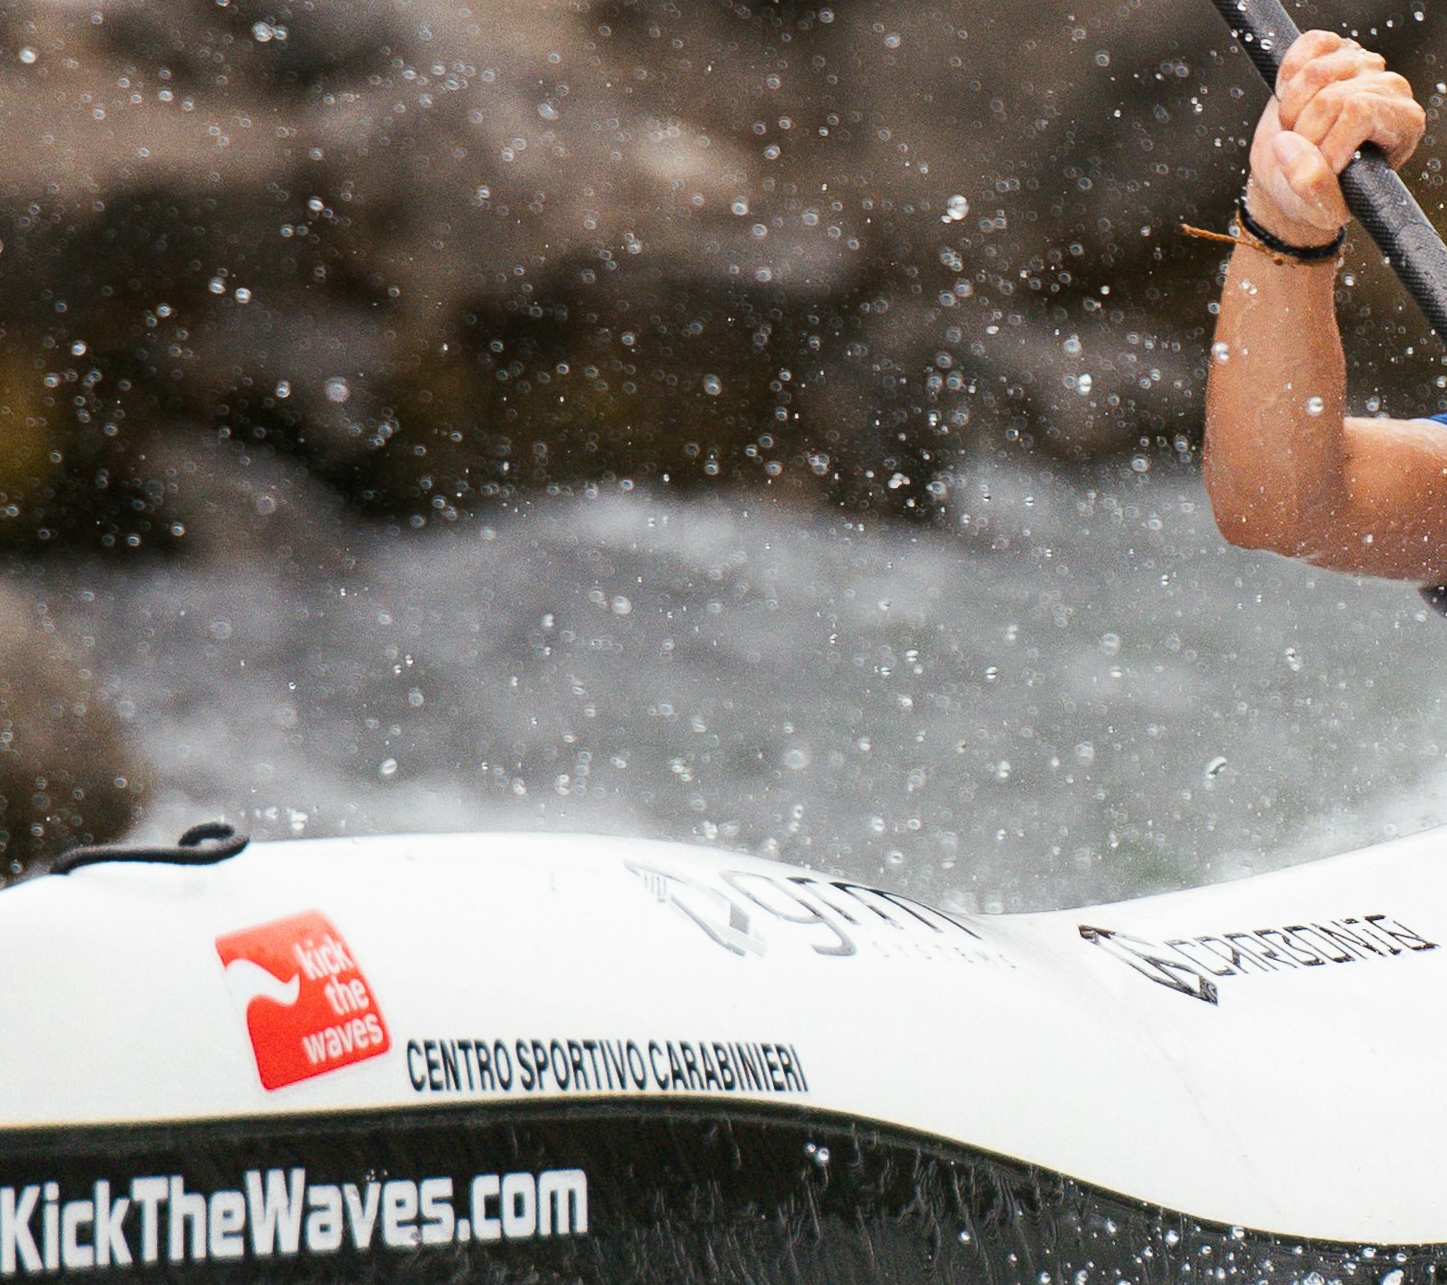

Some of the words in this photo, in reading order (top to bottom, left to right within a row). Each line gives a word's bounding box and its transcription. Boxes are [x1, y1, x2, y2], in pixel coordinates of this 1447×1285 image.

[293, 933, 355, 981] kick
[324, 974, 370, 1016] the
[301, 1013, 384, 1065] waves
[406, 1039, 514, 1092] CENTRO
[515, 1039, 647, 1092] SPORTIVO
[648, 1039, 810, 1093] CARABINIERI
